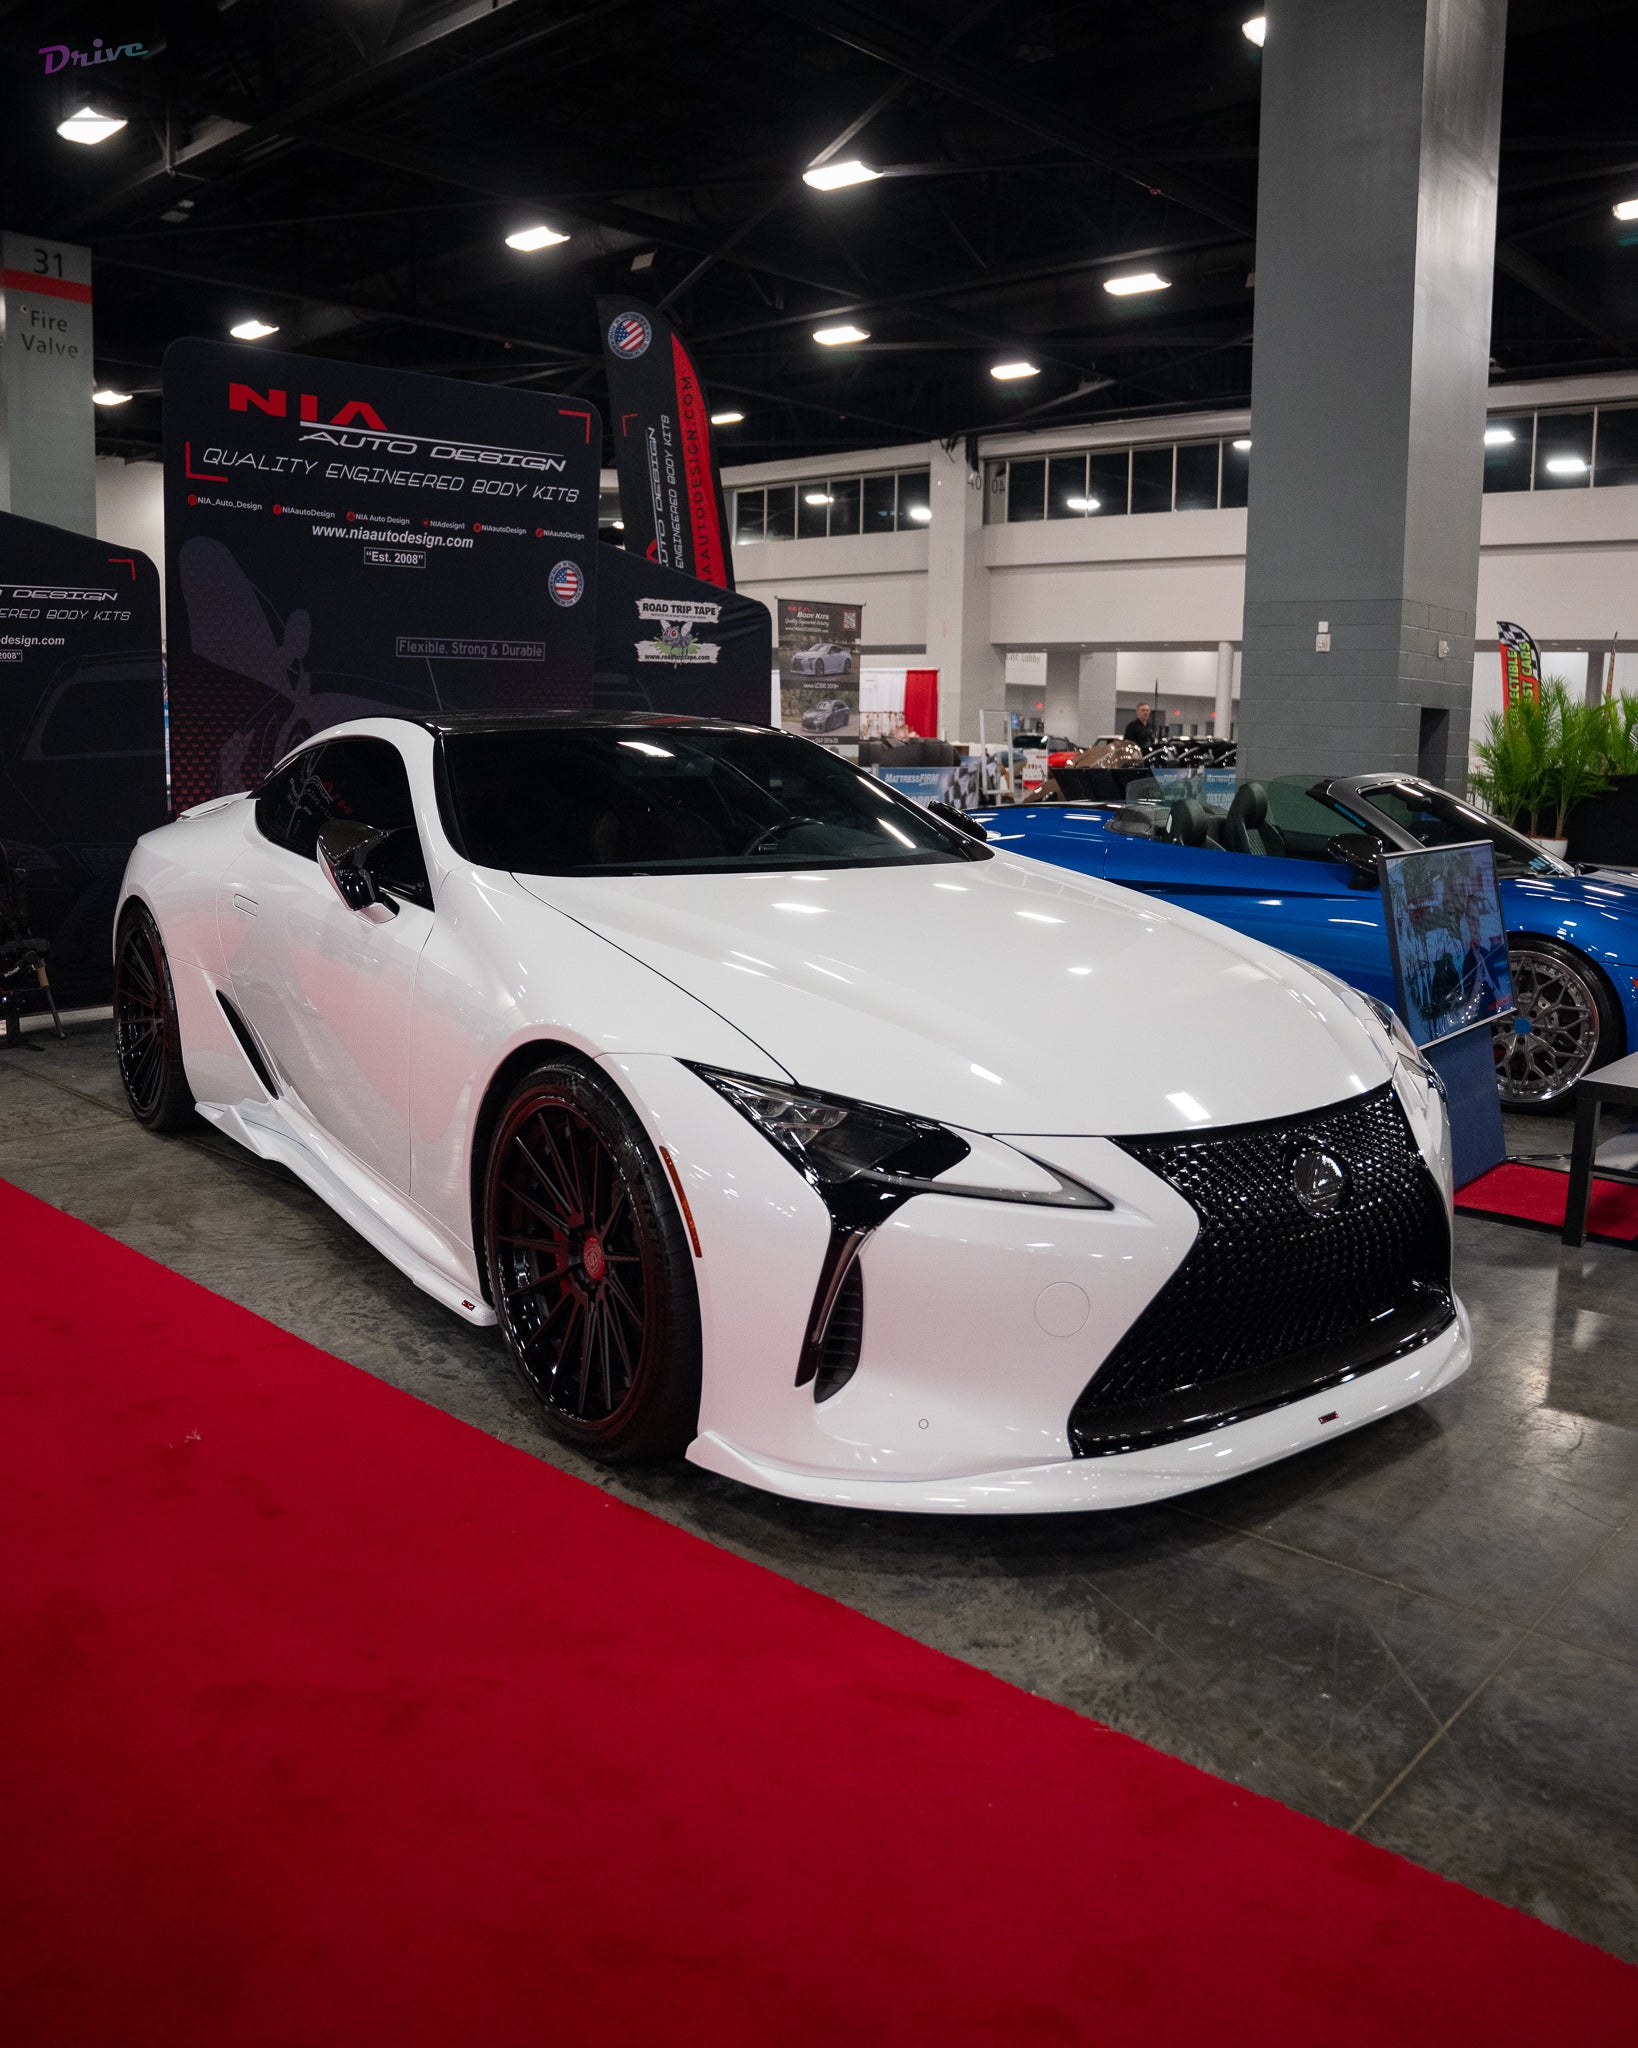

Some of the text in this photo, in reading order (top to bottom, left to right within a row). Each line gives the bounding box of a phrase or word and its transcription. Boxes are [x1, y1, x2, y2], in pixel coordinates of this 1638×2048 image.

[33, 248, 63, 278] 31
[31, 309, 68, 332] Fire
[21, 334, 78, 360] Valve
[229, 382, 388, 431] NIA
[298, 431, 567, 472] AUTO DESIGN
[203, 447, 580, 503] QUALITY ENGINEERED BODY KITS
[648, 427, 663, 511] DESIGN
[661, 414, 684, 569] ENGINEERED BODY KITS
[355, 513, 410, 525] NIA Auto Design
[312, 525, 474, 549] www.niaautodesign.com
[12, 589, 118, 602] DESIGN
[46, 609, 89, 620] BODY
[93, 611, 131, 621] KITS
[642, 602, 668, 613] ROAD
[671, 604, 692, 614] TRIP
[694, 606, 716, 616] TAPE
[399, 640, 543, 659] Flexible, Strong & Durable
[1519, 641, 1534, 677] CARS
